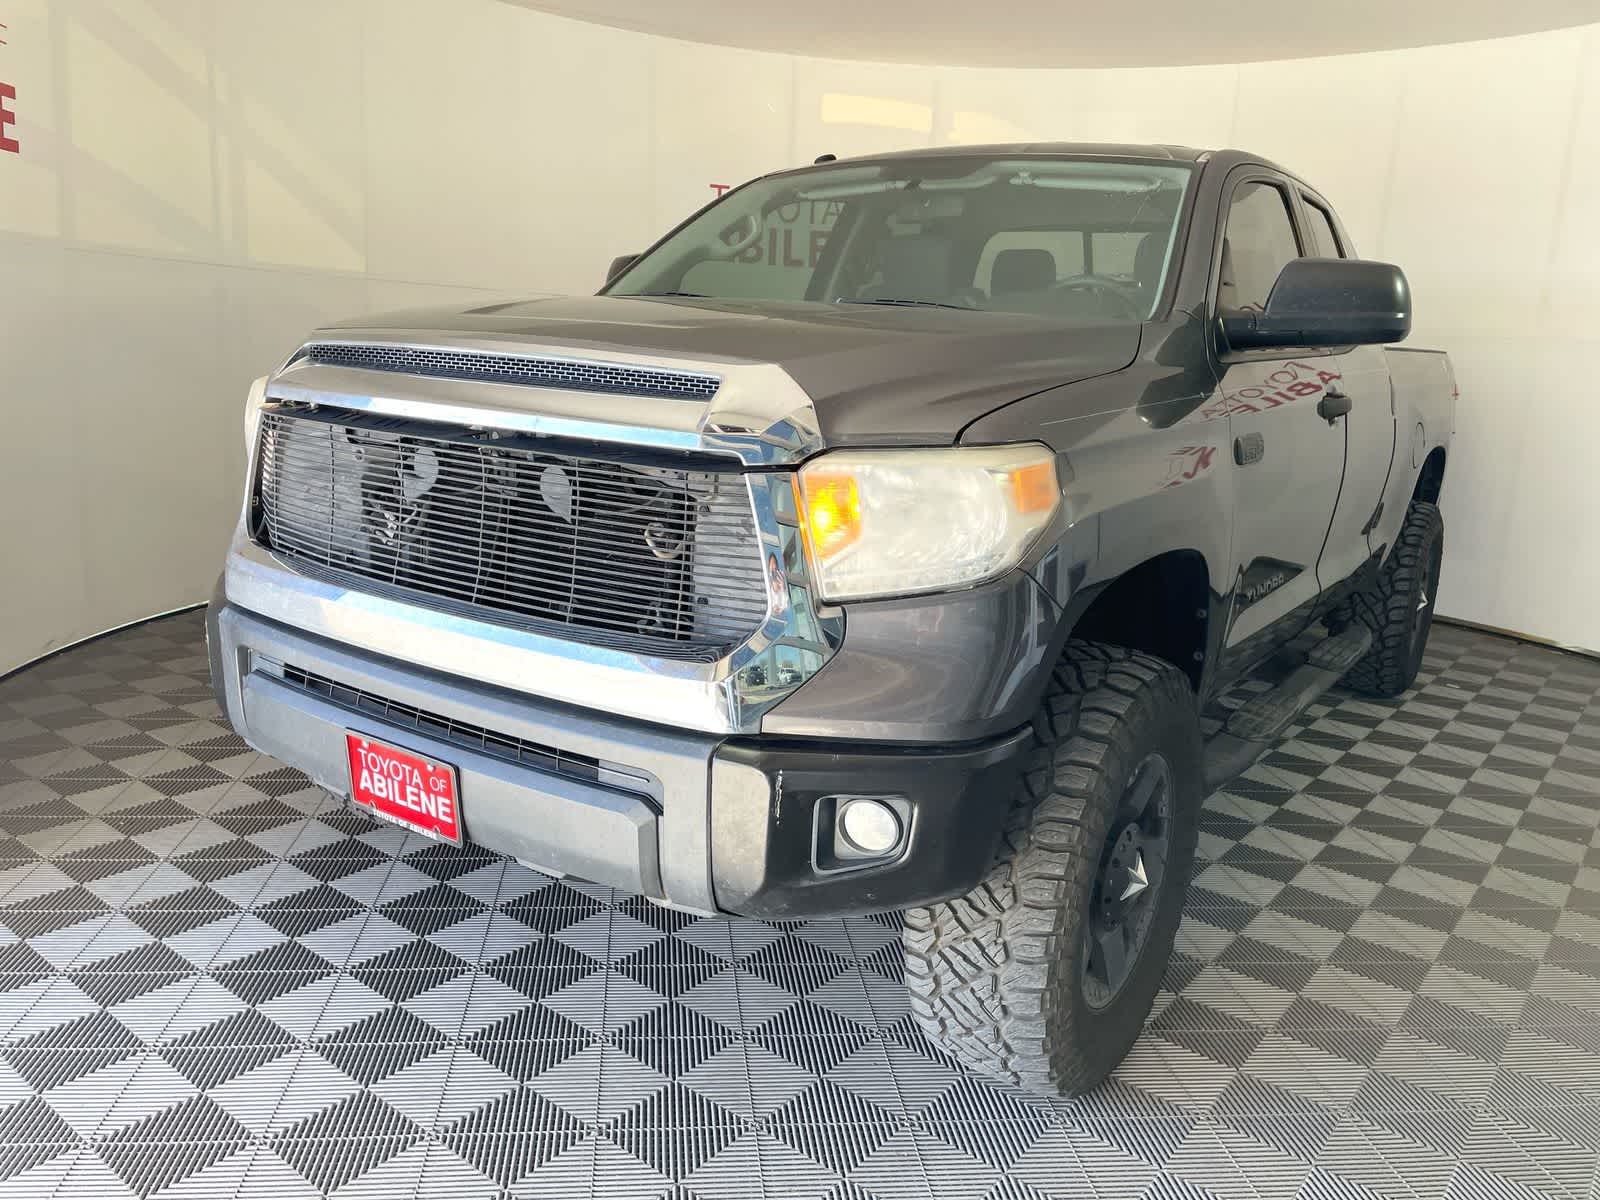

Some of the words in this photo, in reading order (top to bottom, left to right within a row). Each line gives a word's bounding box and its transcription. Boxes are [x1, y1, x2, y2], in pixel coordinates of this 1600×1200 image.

[358, 748, 424, 789] TOYOTA
[429, 776, 448, 793] OF
[360, 769, 453, 823] ABILENE
